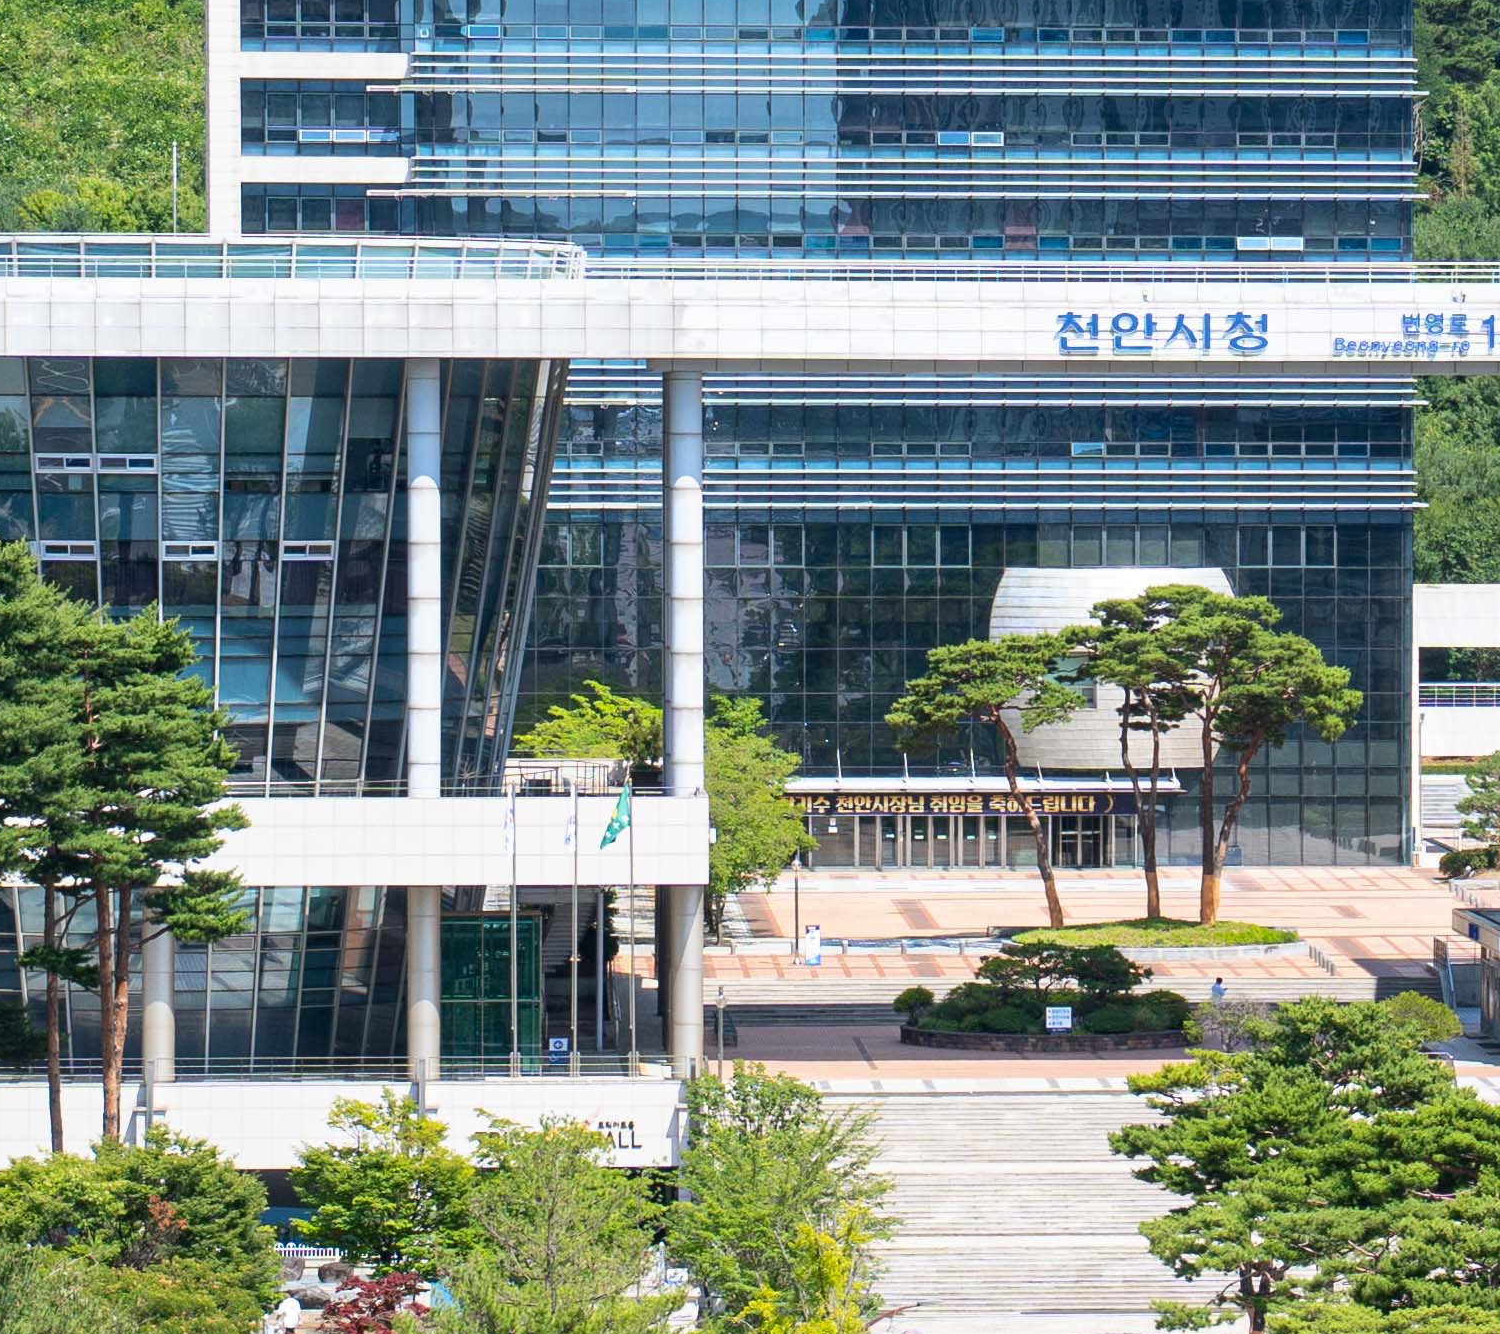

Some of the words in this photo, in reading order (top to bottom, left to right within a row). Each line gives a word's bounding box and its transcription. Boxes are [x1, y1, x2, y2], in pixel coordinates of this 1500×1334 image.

[1057, 312, 1268, 352] 천안시청
[1402, 313, 1469, 335] 번영로
[836, 795, 925, 813] 천안시장님
[930, 795, 983, 813] 취임을
[603, 1130, 643, 1149] ALL
